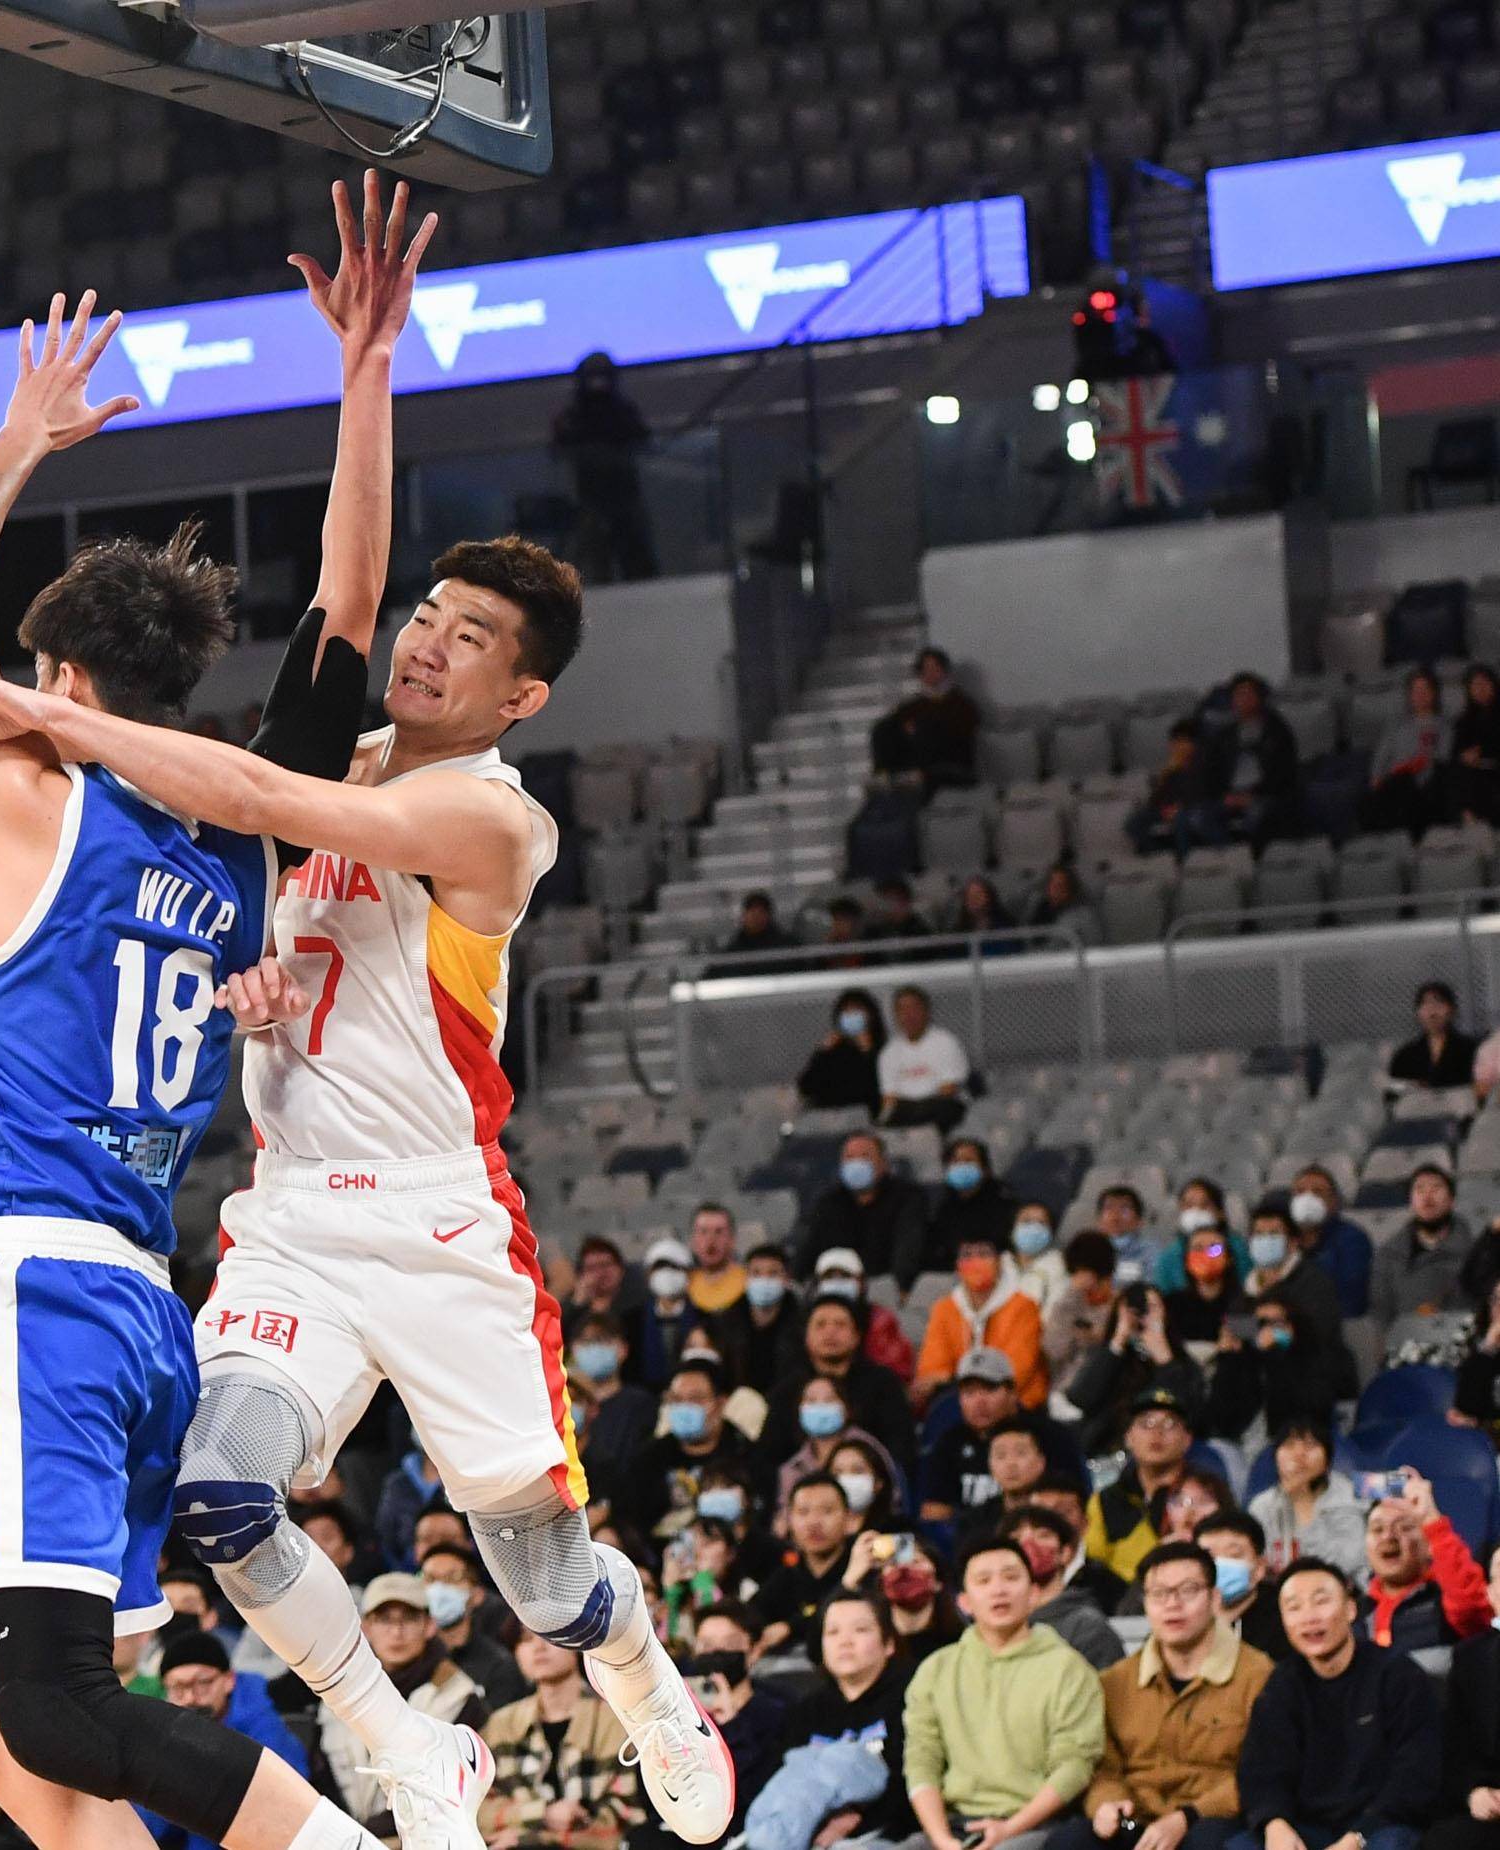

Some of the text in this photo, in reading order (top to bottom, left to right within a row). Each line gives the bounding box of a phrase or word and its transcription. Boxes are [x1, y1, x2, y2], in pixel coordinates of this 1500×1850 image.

[135, 867, 235, 945] WU I.P.
[280, 853, 381, 902] HINA
[107, 939, 215, 1112] 18
[294, 936, 344, 1055] 7
[328, 1174, 376, 1189] CHN
[205, 1310, 298, 1353] 中国
